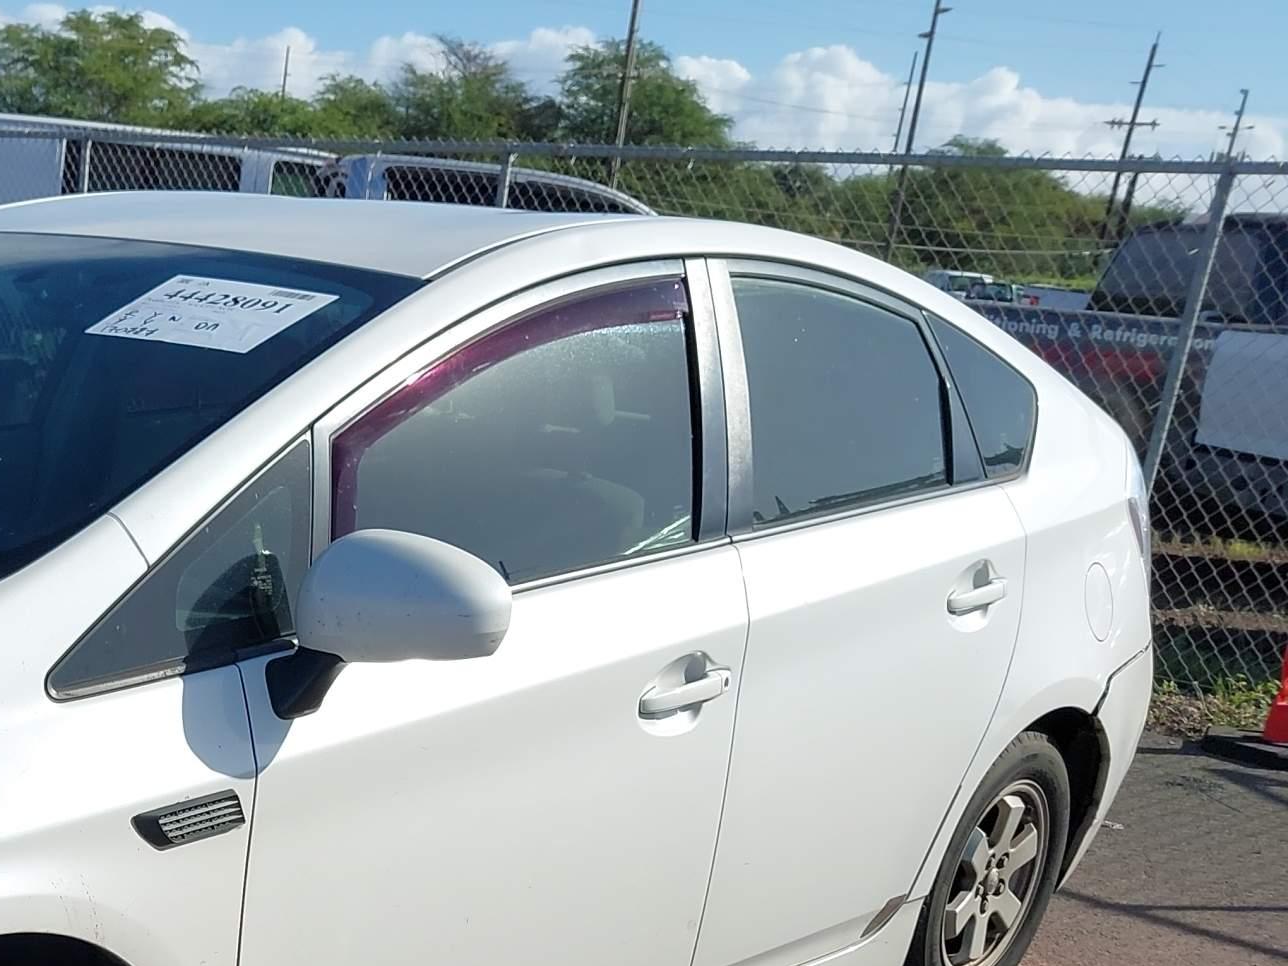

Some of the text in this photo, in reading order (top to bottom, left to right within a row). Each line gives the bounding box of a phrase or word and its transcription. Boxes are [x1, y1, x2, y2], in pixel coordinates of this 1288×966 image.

[162, 288, 294, 315] 44428091
[1067, 321, 1081, 339] &
[1090, 323, 1216, 351] Refrigeraon
